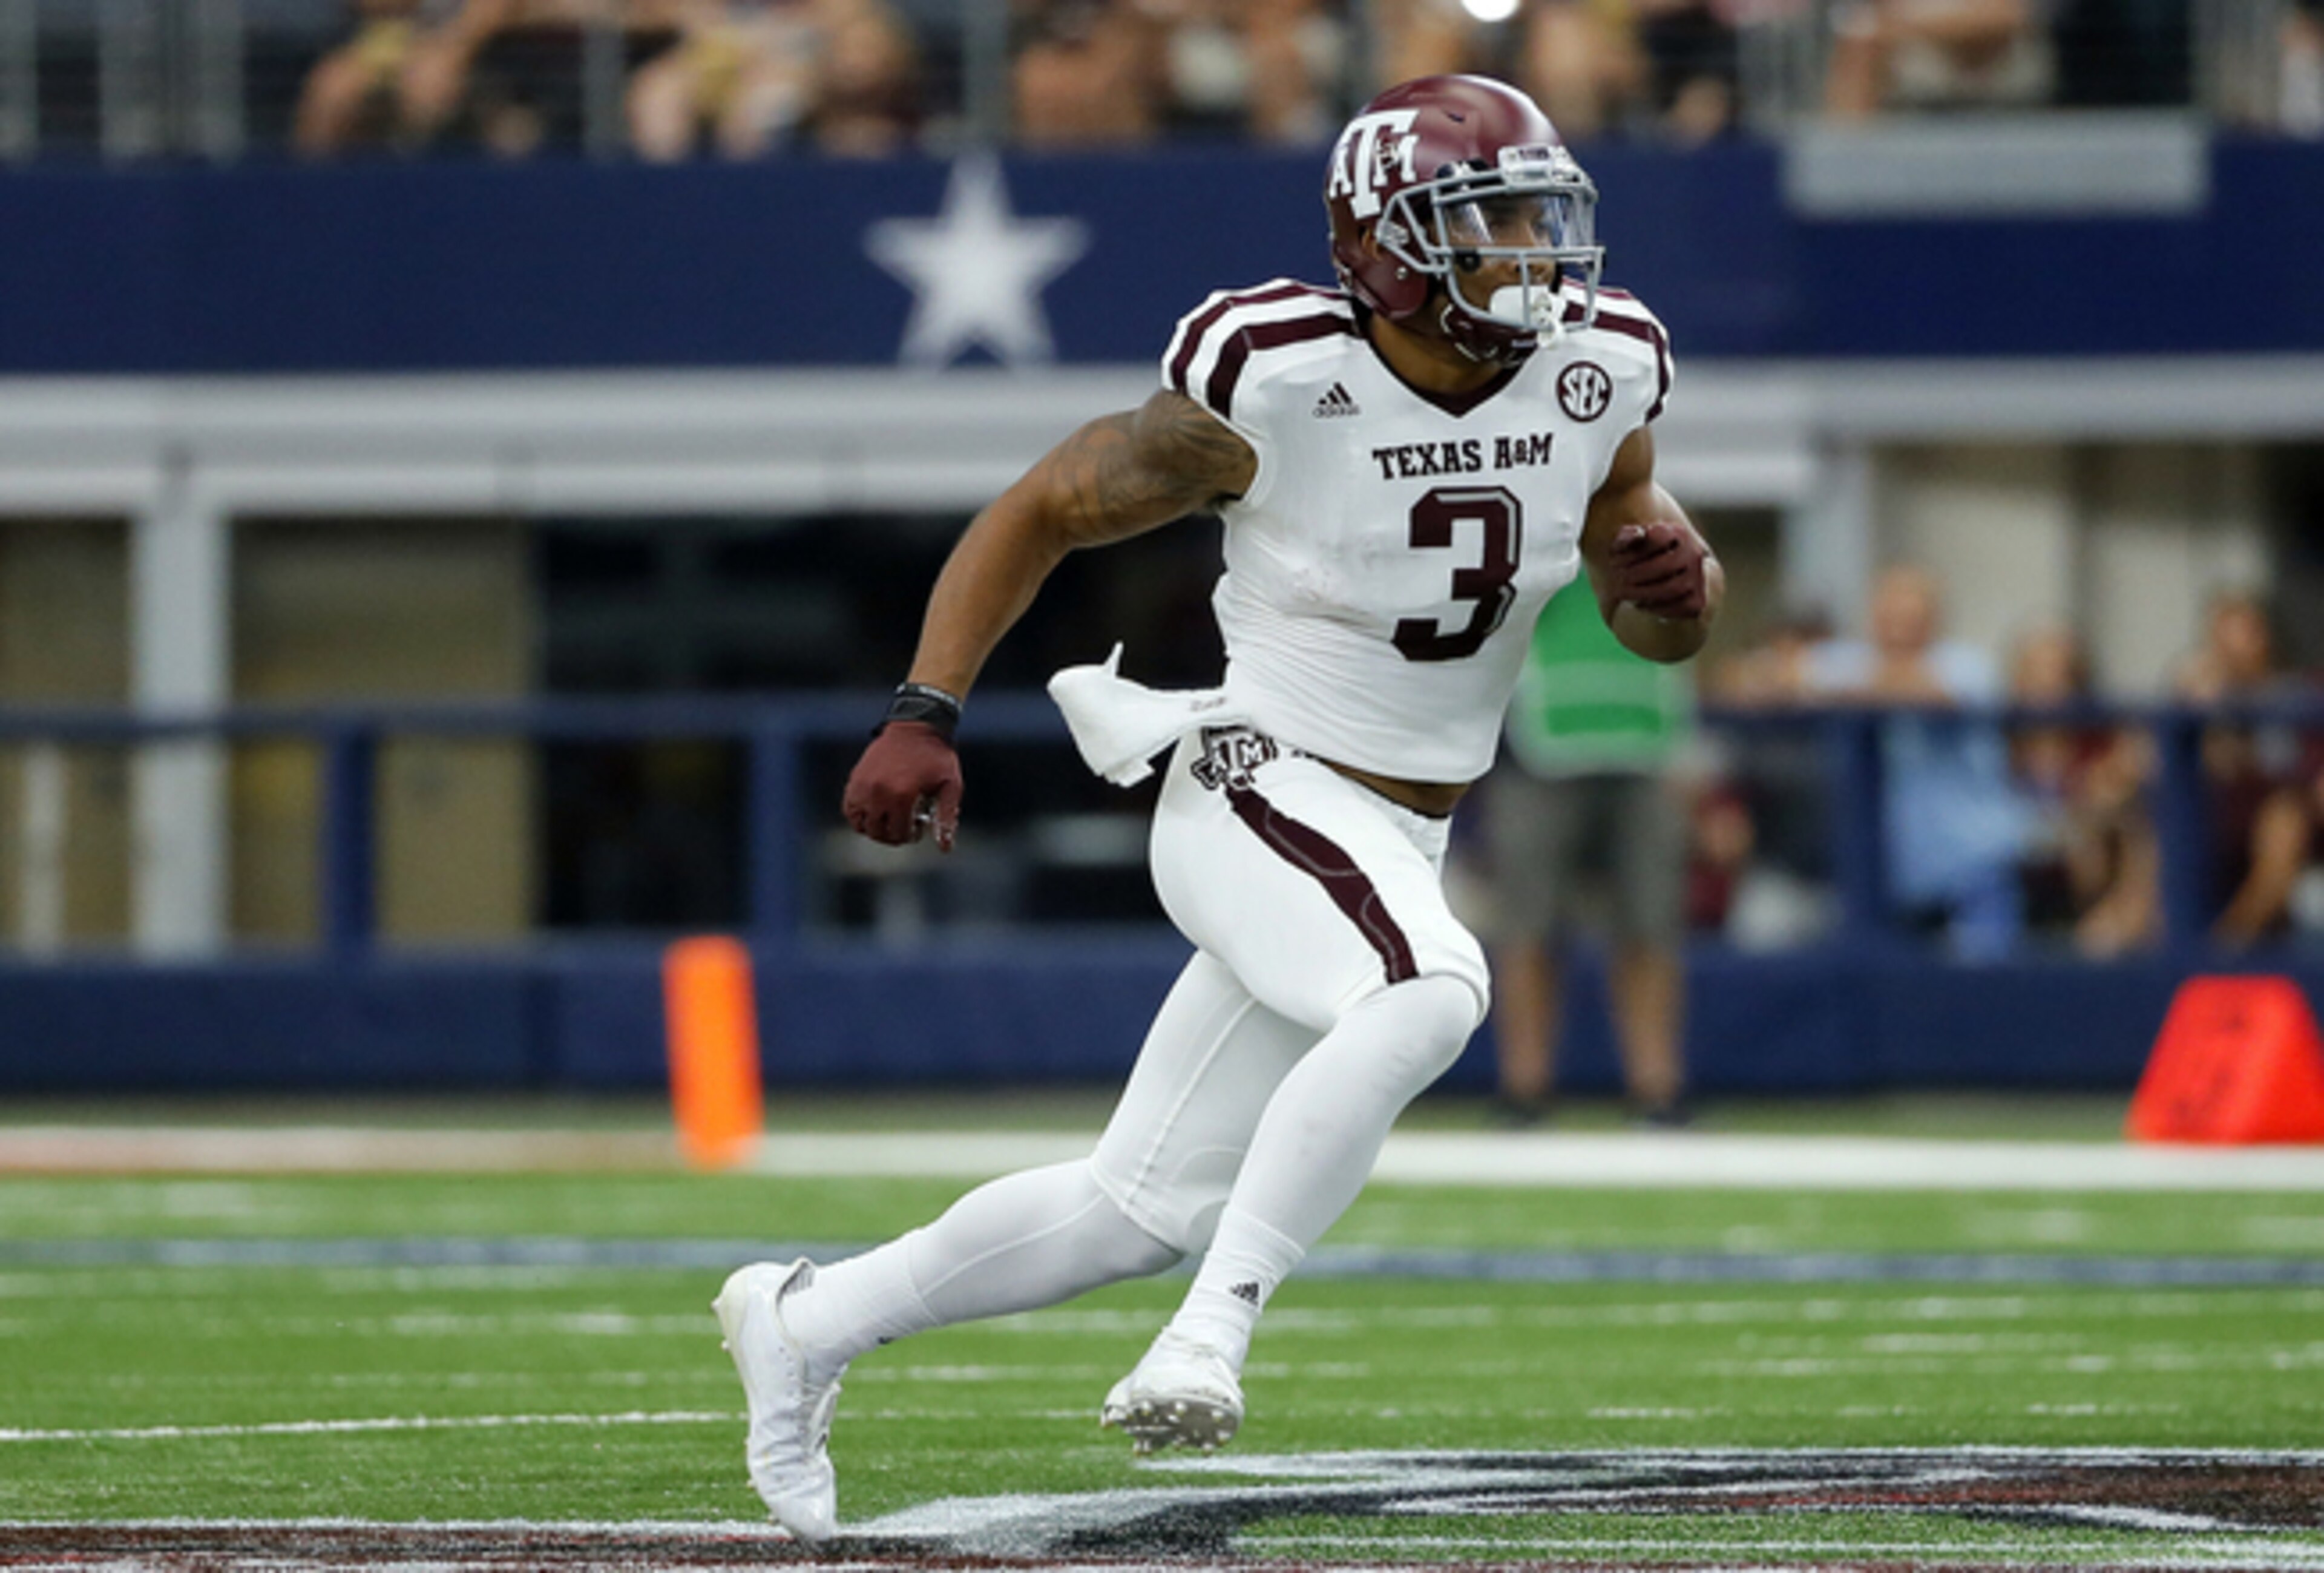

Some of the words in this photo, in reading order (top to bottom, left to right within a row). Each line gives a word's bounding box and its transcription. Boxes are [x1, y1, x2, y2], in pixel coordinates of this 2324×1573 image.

[1561, 367, 1607, 416] SEC
[1372, 439, 1482, 480] TEXAS
[1494, 432, 1554, 469] A&M
[1391, 485, 1523, 662] 3
